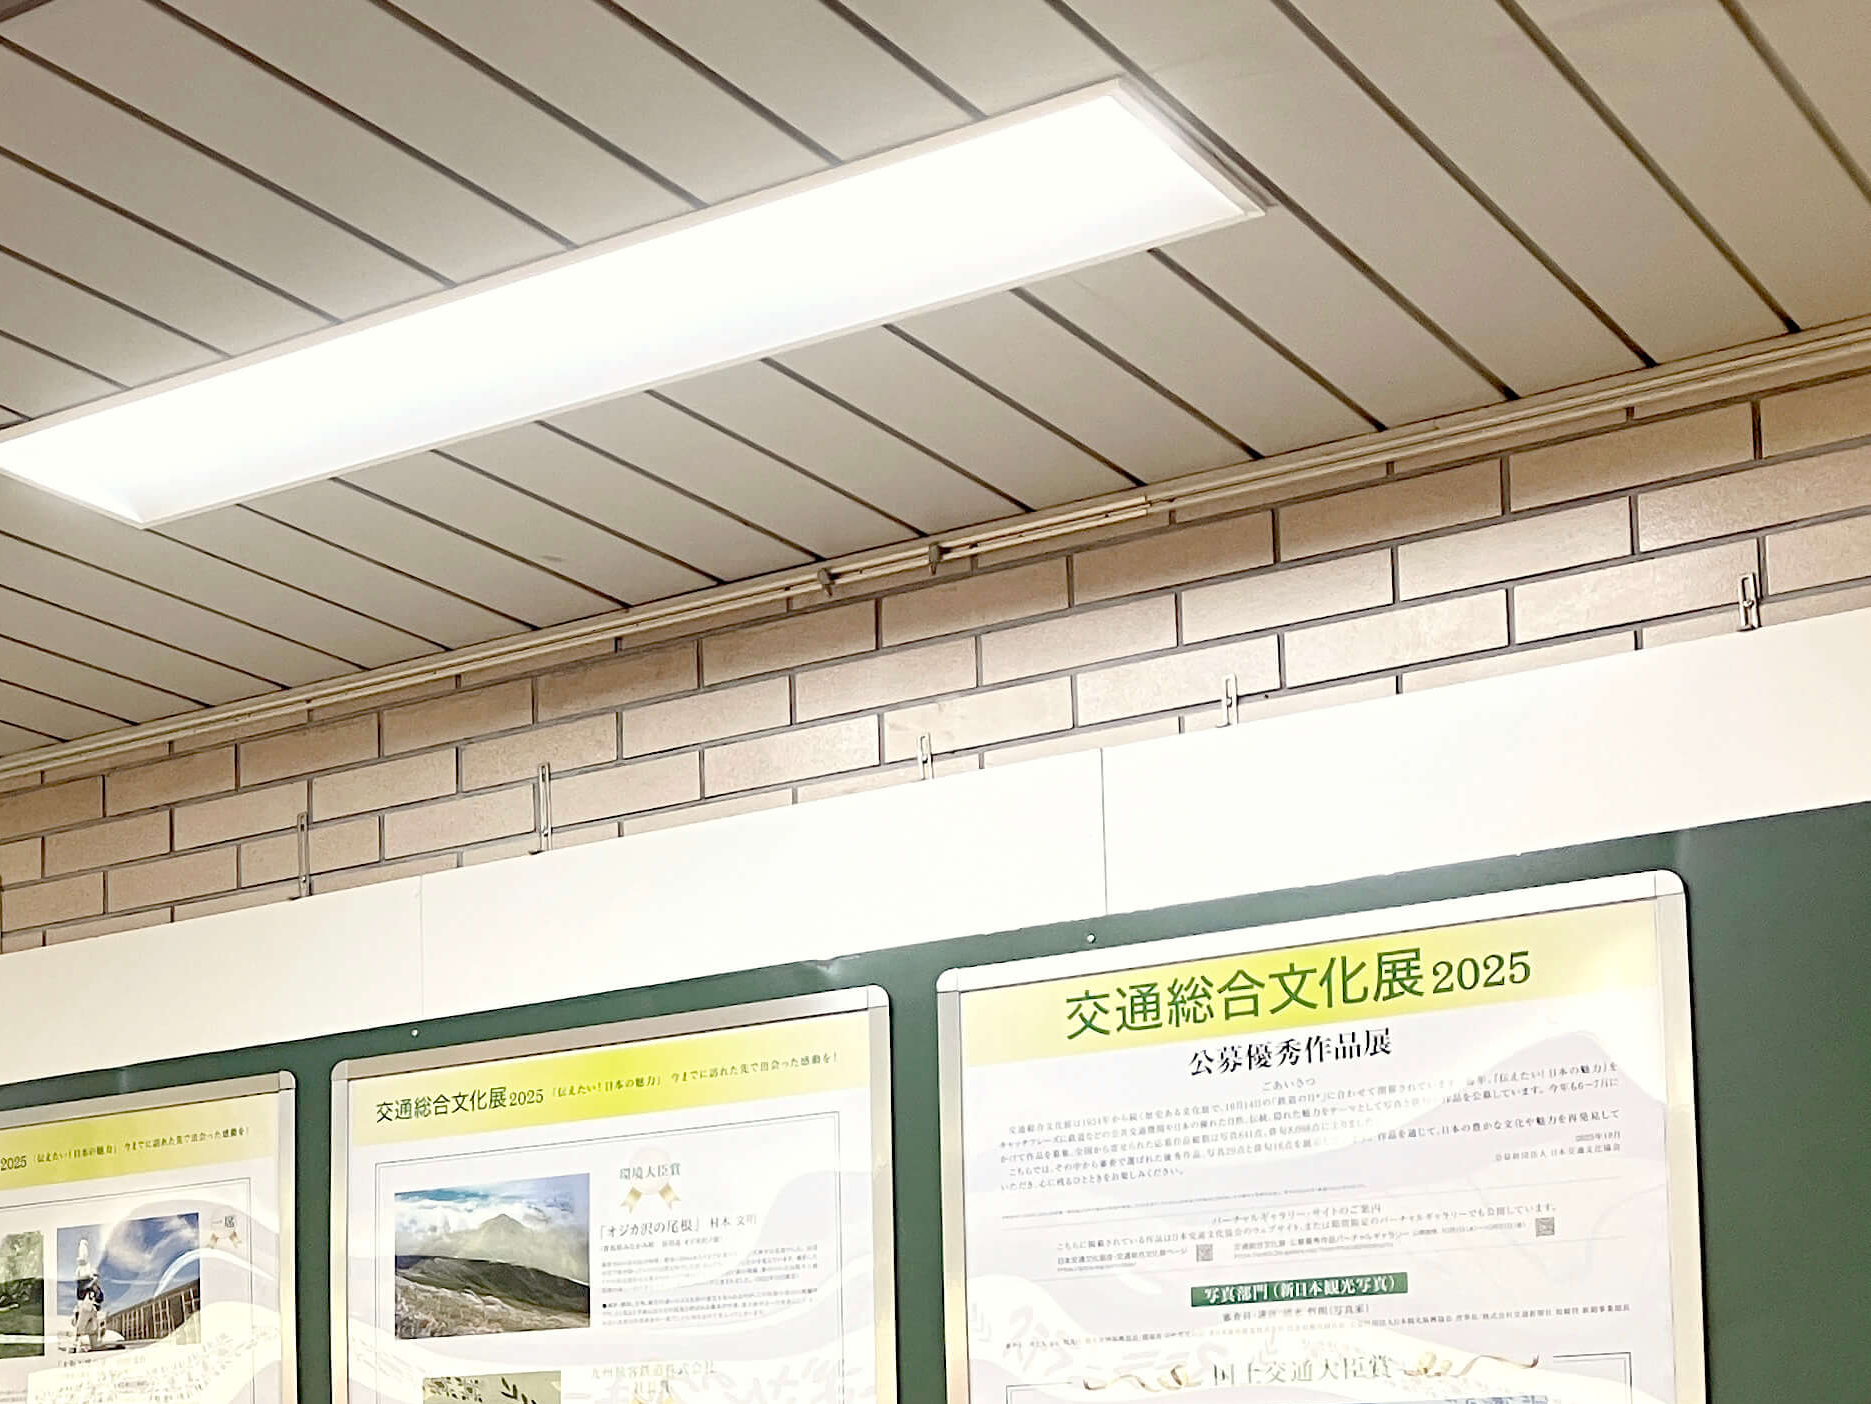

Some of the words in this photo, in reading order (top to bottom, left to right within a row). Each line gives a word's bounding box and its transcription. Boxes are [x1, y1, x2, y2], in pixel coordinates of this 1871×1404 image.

[1188, 1027, 1392, 1077] 公募優秀作品展
[376, 1086, 544, 1124] 交通総合文化展2025
[619, 1162, 681, 1180] 環境大臣賞
